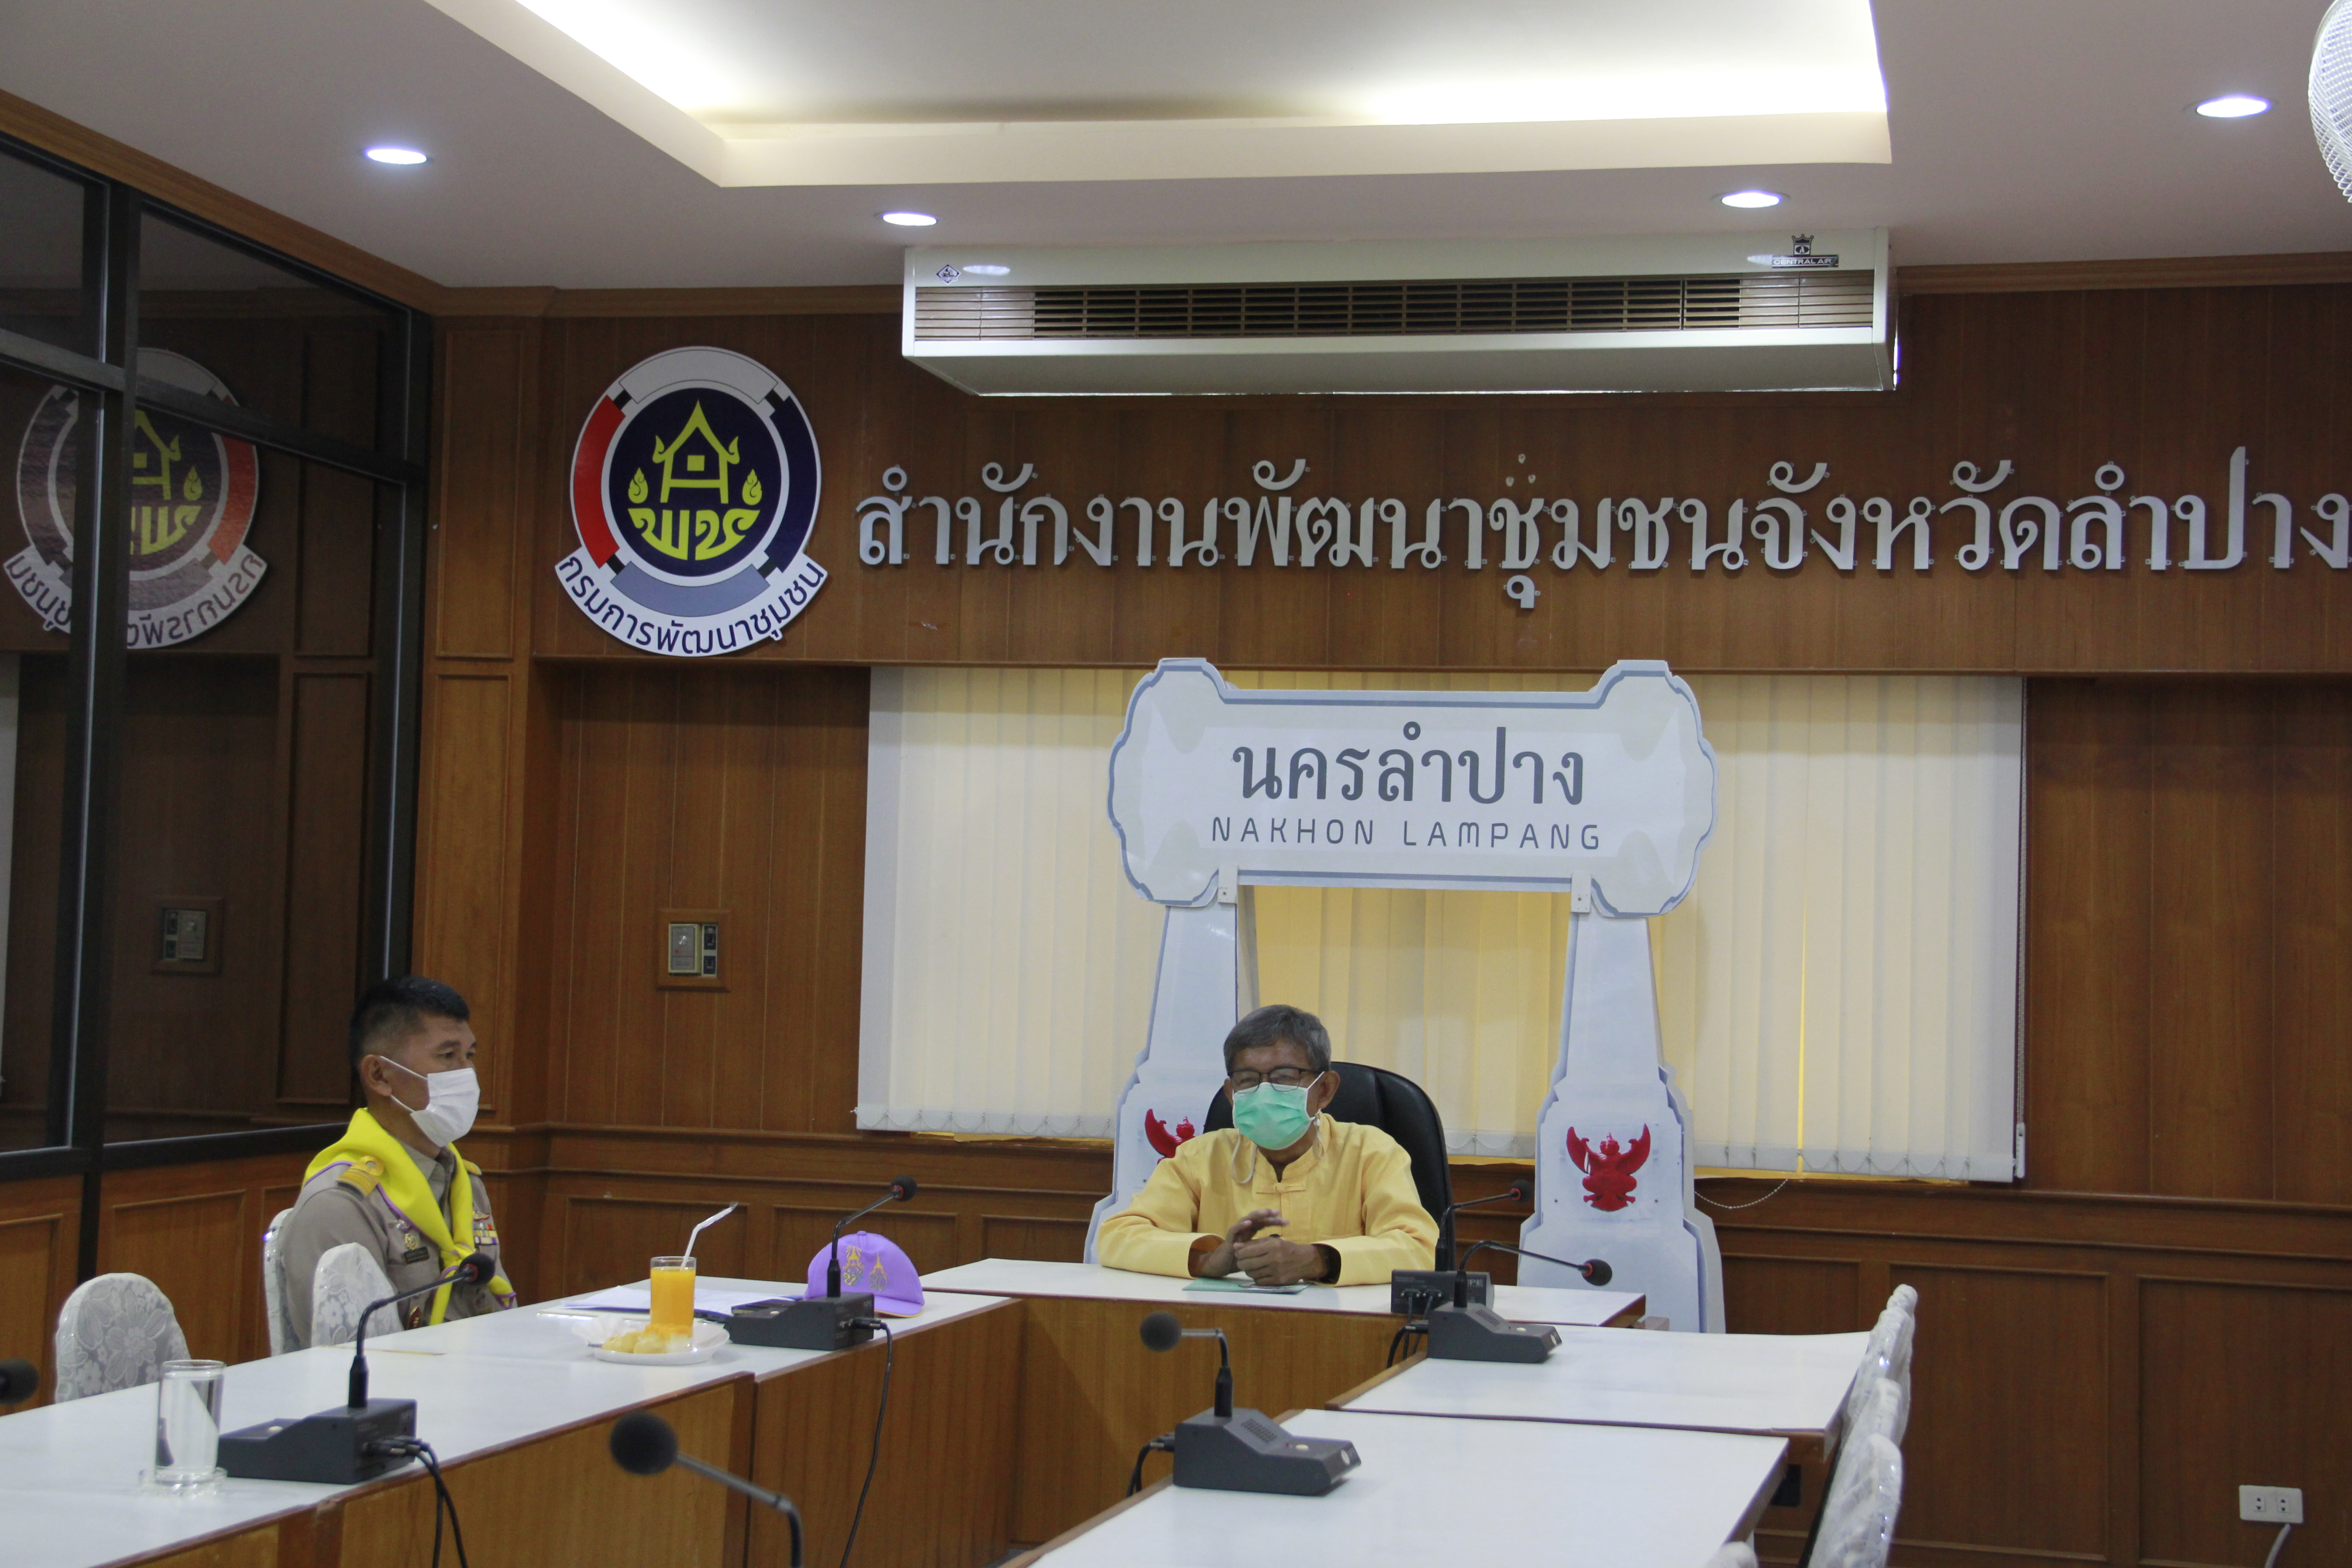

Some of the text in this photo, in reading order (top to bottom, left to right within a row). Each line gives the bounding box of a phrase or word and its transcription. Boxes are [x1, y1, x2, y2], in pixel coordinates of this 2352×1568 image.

[856, 446, 2349, 609] สำนักงานพัฒนาชุมชนจังหวัดลำปาง
[559, 556, 824, 654] กรมการพัฒนาชุมชน
[1233, 721, 1583, 805] นครลำปาง
[1212, 817, 1599, 850] NAKHON LAMPANG
